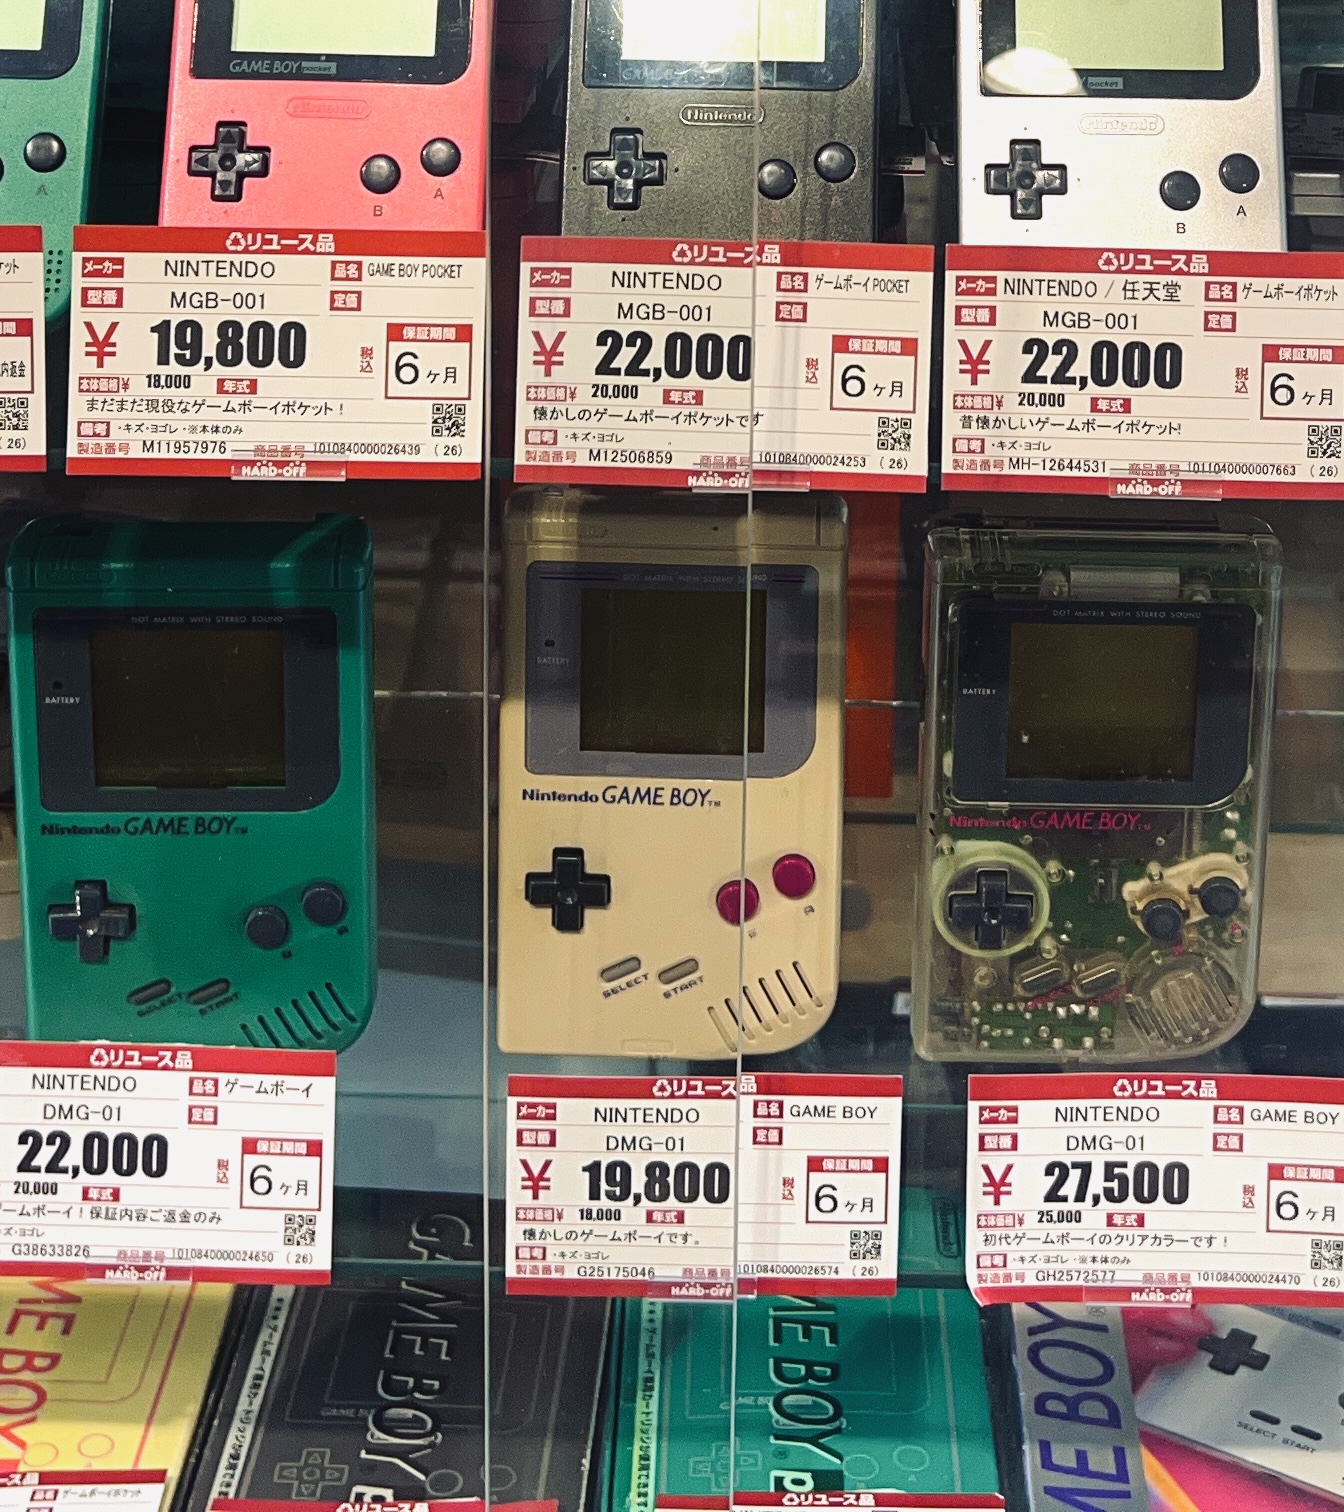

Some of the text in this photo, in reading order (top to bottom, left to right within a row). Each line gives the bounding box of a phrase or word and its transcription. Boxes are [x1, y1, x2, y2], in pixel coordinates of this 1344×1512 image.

[230, 60, 334, 76] GAME BOY pocket
[163, 259, 276, 279] NINTENDO
[367, 263, 463, 279] GAME BOY POCKET
[610, 270, 722, 292] NINTENDO
[1003, 278, 1097, 298] NINTENDO
[170, 291, 266, 310] MGB-001
[616, 302, 713, 322] MGB-001
[1042, 310, 1139, 330] MGB-001
[149, 318, 307, 372] 19,800
[594, 329, 752, 383] 22,000
[1020, 337, 1184, 392] 22,000
[521, 784, 712, 808] Nintendo GAME BOY
[600, 971, 651, 1000] SELECT
[662, 975, 706, 1001] START
[594, 1106, 700, 1124] NINTENDO
[790, 1104, 878, 1120] GAME BOY
[1054, 1106, 1160, 1123] NINTENDO
[605, 1135, 686, 1153] DMG-01
[1066, 1135, 1146, 1152] DMG-01
[581, 1159, 731, 1208] 19,800
[1043, 1160, 1190, 1208] 27,500
[1026, 1302, 1122, 1430] BOY
[1236, 1420, 1278, 1442] SELECT
[1281, 1436, 1318, 1455] START
